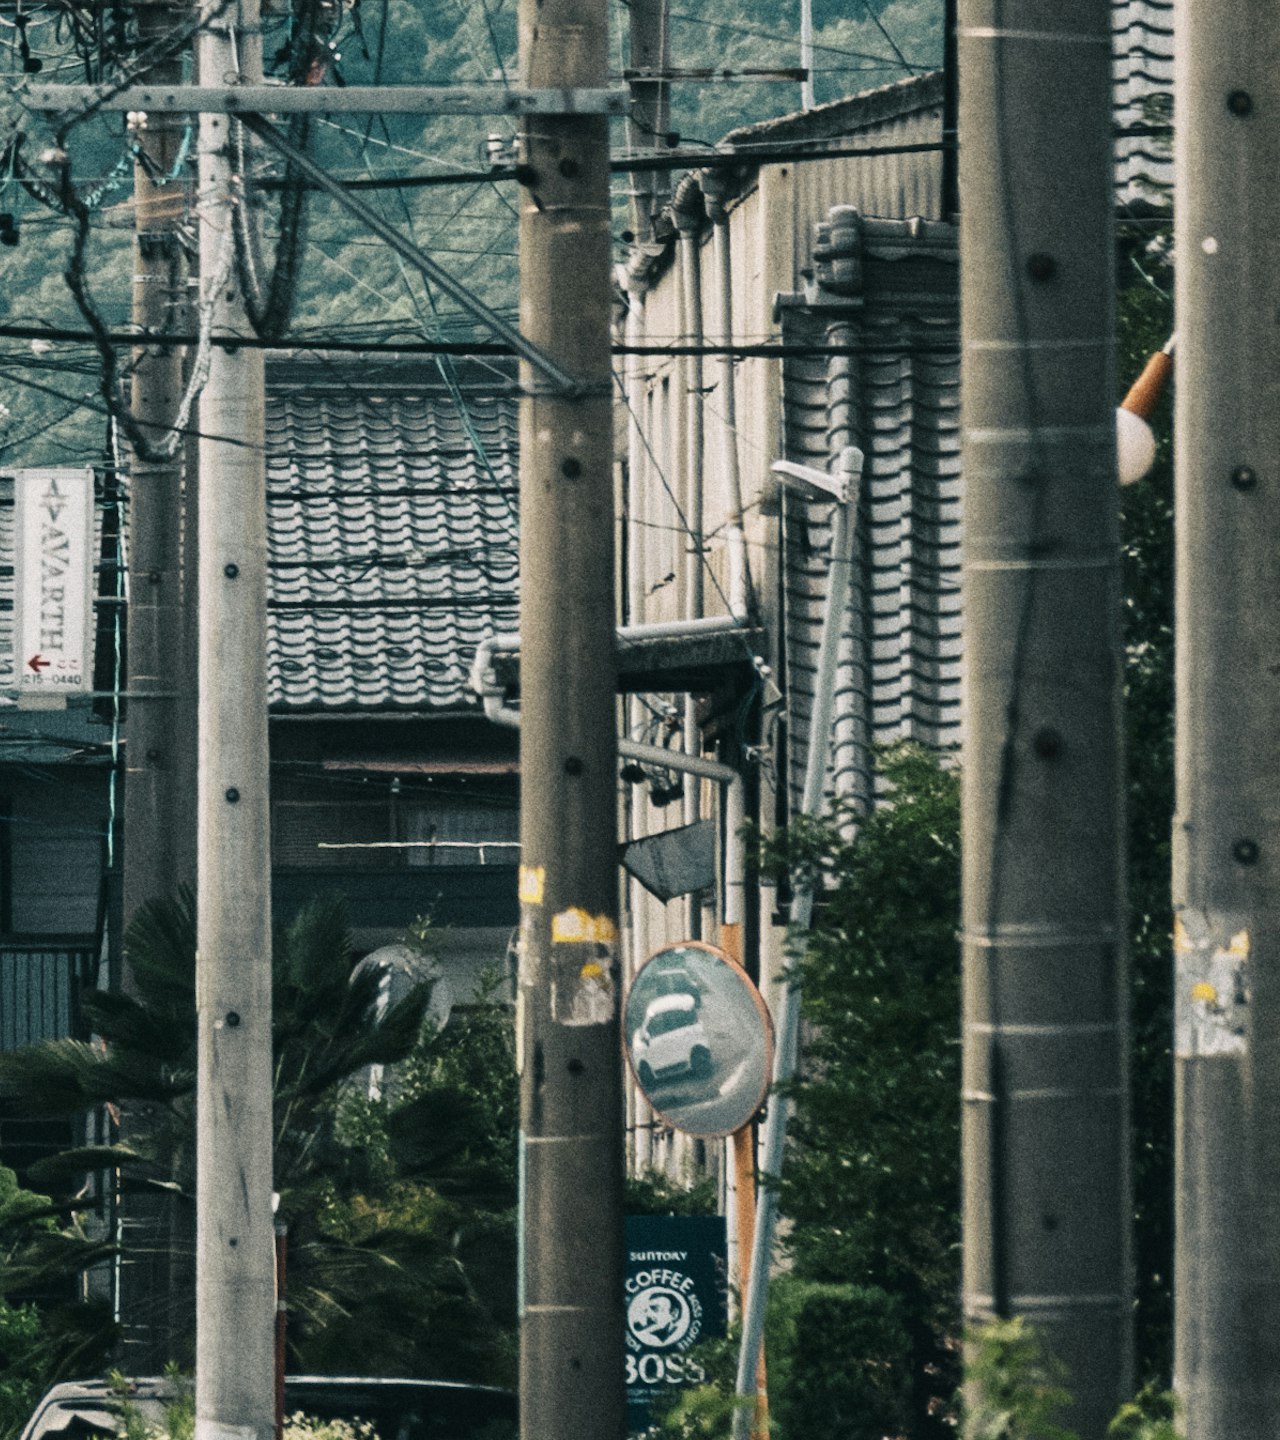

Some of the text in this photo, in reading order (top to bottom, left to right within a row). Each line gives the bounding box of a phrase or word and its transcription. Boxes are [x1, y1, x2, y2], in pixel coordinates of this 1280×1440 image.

[40, 522, 70, 652] AVARTH
[630, 1251, 688, 1262] SUNTORY
[625, 1268, 695, 1294] COFFEE
